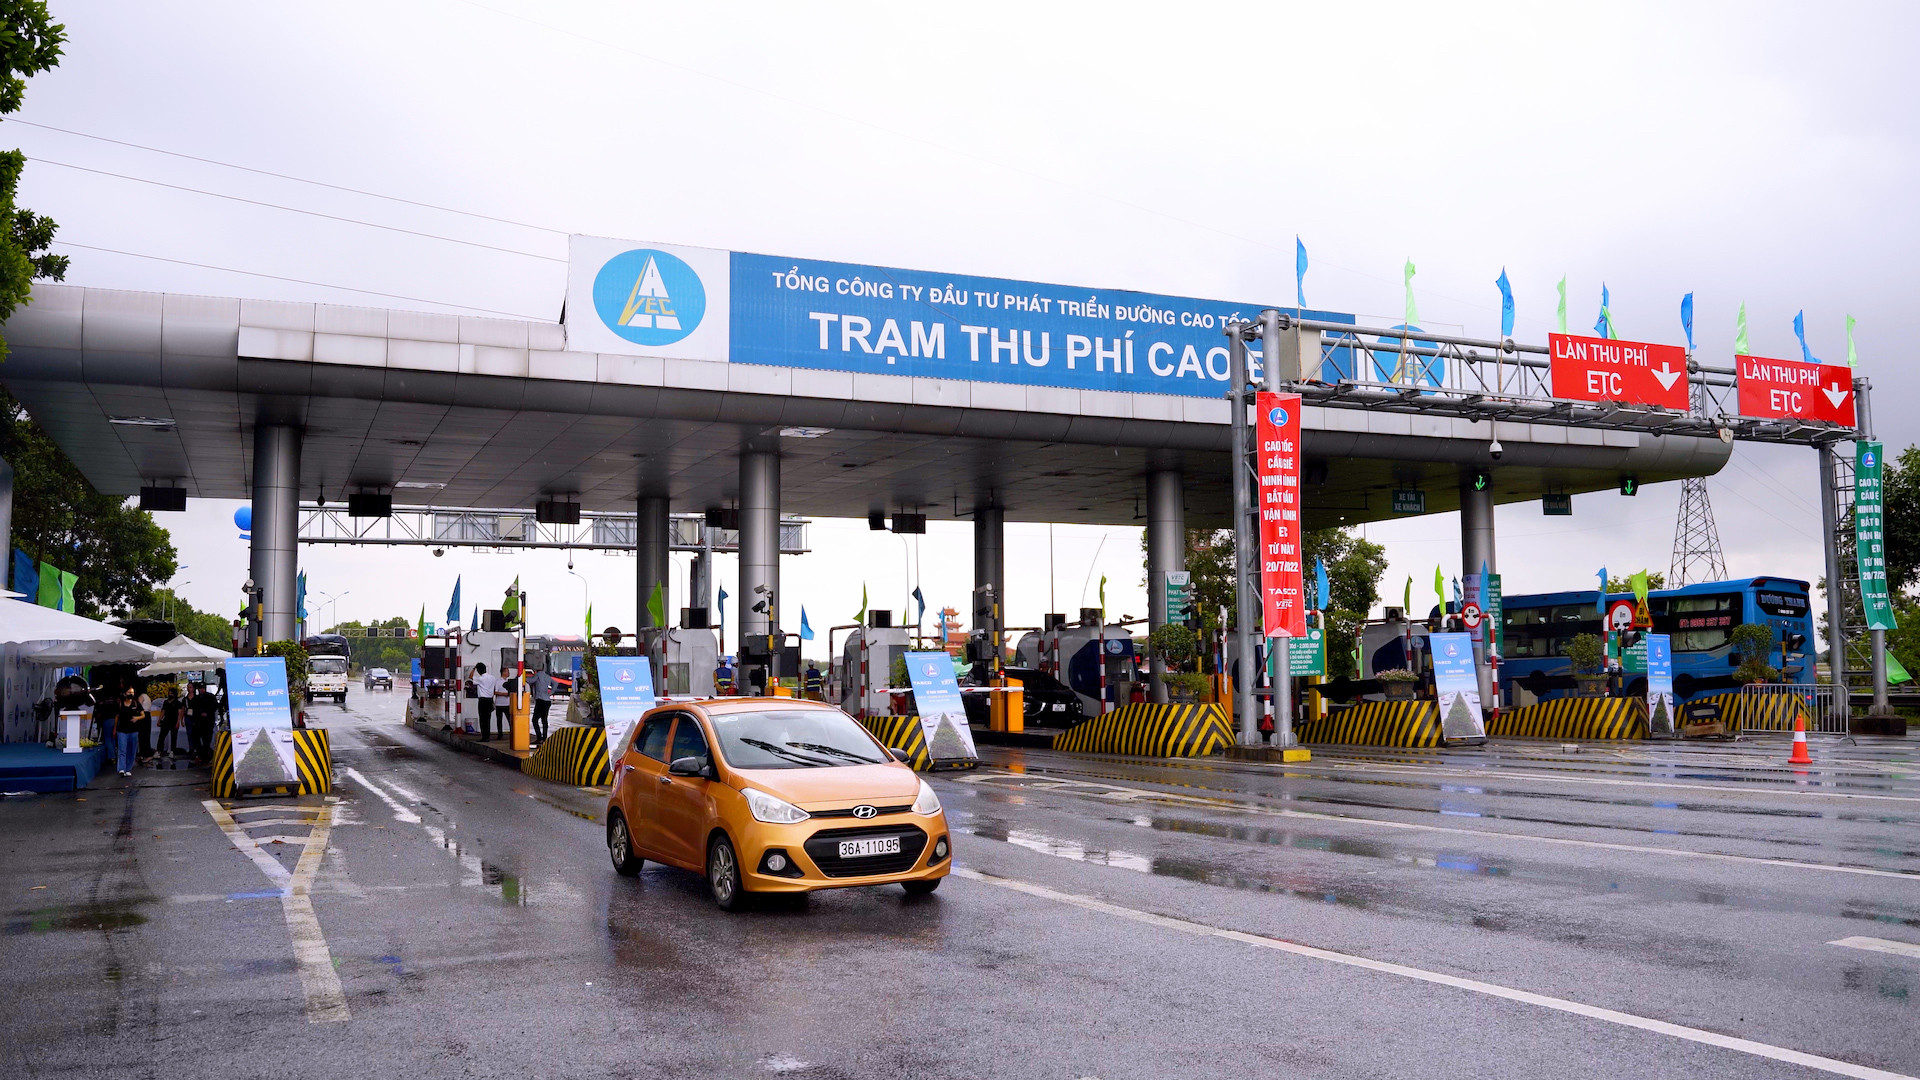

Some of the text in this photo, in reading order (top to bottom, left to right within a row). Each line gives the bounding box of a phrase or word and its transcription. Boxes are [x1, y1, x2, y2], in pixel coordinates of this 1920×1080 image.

[772, 266, 829, 293] TỔNG
[836, 277, 893, 299] CÔNG
[899, 285, 923, 301] TY
[929, 283, 968, 306] ĐẦU
[974, 292, 999, 308] TƯ
[1004, 294, 1052, 313] PHÁT
[1057, 296, 1110, 319] TRIỂN
[1115, 304, 1176, 325] ĐƯỜNG
[1181, 312, 1214, 329] CAO
[809, 312, 945, 364] TRẠM
[960, 325, 1050, 367] THU
[1066, 331, 1134, 374] PHÍ
[1148, 342, 1231, 382] CAO
[1556, 337, 1648, 366] LÀN THU PHÍ
[1743, 359, 1820, 386] LÀN THU PHÍ
[1587, 370, 1622, 395] ETC
[1770, 389, 1802, 413] ETC
[1264, 441, 1281, 452] CAO
[1262, 475, 1282, 486] NINH
[1859, 479, 1871, 487] CAO
[1267, 488, 1282, 503] BẮT
[1264, 508, 1280, 522] VẬN
[1268, 542, 1280, 555] TỪ
[1266, 561, 1298, 572] 20/7/022
[842, 839, 899, 855] 36A-110.95
